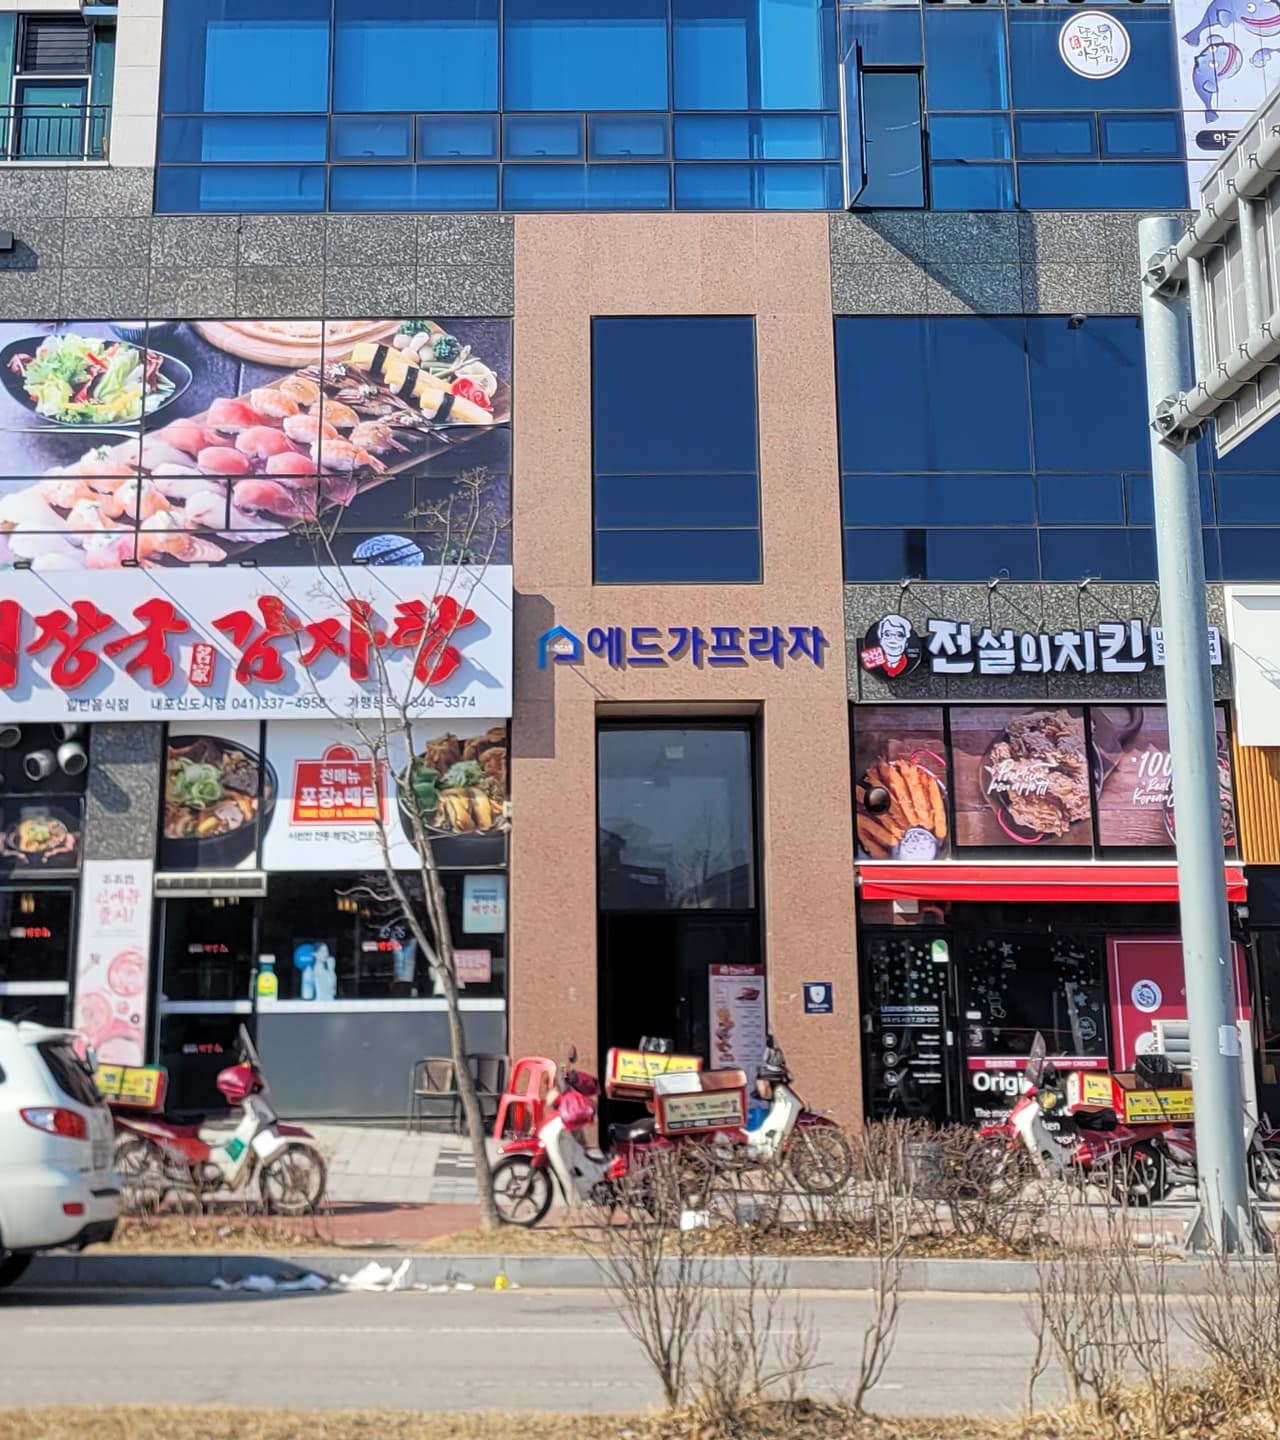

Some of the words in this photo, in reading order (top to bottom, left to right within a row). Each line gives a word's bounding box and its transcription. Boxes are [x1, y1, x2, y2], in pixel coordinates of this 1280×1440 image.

[211, 594, 478, 687] 감자탕
[586, 626, 828, 667] 에드가프라자
[66, 697, 130, 713] 일반음식점
[150, 696, 227, 712] 내포신도시점
[972, 1071, 1024, 1096] Origi
